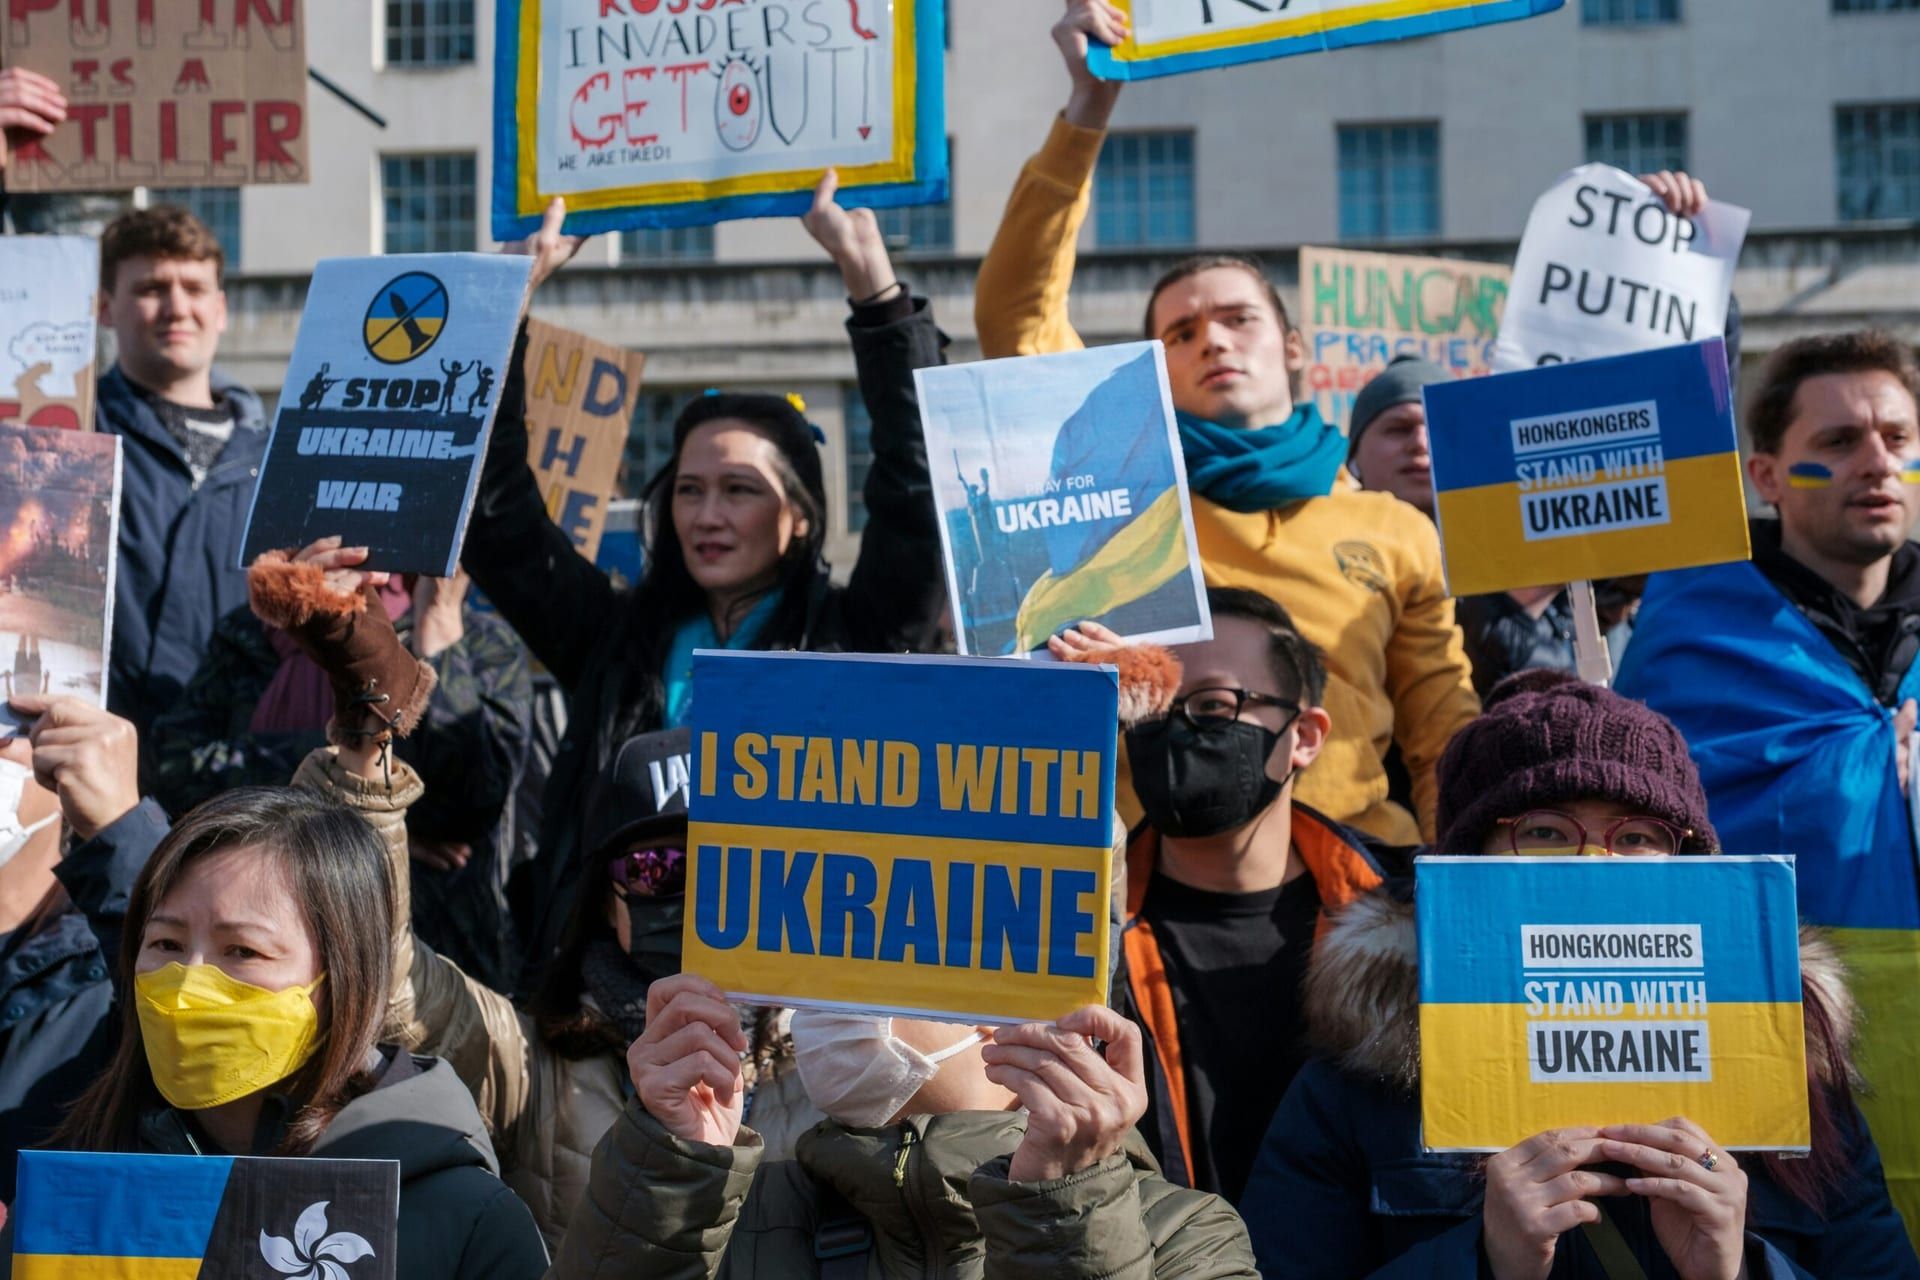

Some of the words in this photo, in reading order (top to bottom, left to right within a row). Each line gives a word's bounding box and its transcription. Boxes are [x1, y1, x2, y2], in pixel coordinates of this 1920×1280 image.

[565, 1, 832, 69] INVADERS
[70, 59, 134, 94] IS
[173, 59, 211, 94] A
[569, 61, 710, 150] GET
[558, 156, 577, 171] WE
[586, 151, 615, 168] ARE
[1568, 184, 1696, 253] STOP
[1539, 262, 1697, 341] PUTIN
[341, 377, 440, 409] STOP
[297, 427, 458, 460] UKRAINE
[1518, 409, 1650, 446] HONGKONGERS
[1025, 479, 1063, 496] PRAY
[1066, 474, 1095, 491] FOR
[1515, 453, 1596, 491] STAND
[1601, 445, 1665, 481] WITH
[316, 480, 402, 512] WAR
[996, 488, 1132, 533] UKRAINE
[1528, 484, 1662, 533] UKRAINE
[700, 731, 719, 797] I
[732, 732, 920, 808] STAND
[935, 743, 1101, 820] WITH
[694, 844, 1097, 979] UKRAINE
[1530, 933, 1693, 959] HONGKONGERS
[1524, 980, 1624, 1017] STAND
[1631, 980, 1708, 1017] WITH
[1536, 1029, 1703, 1074] UKRAINE
